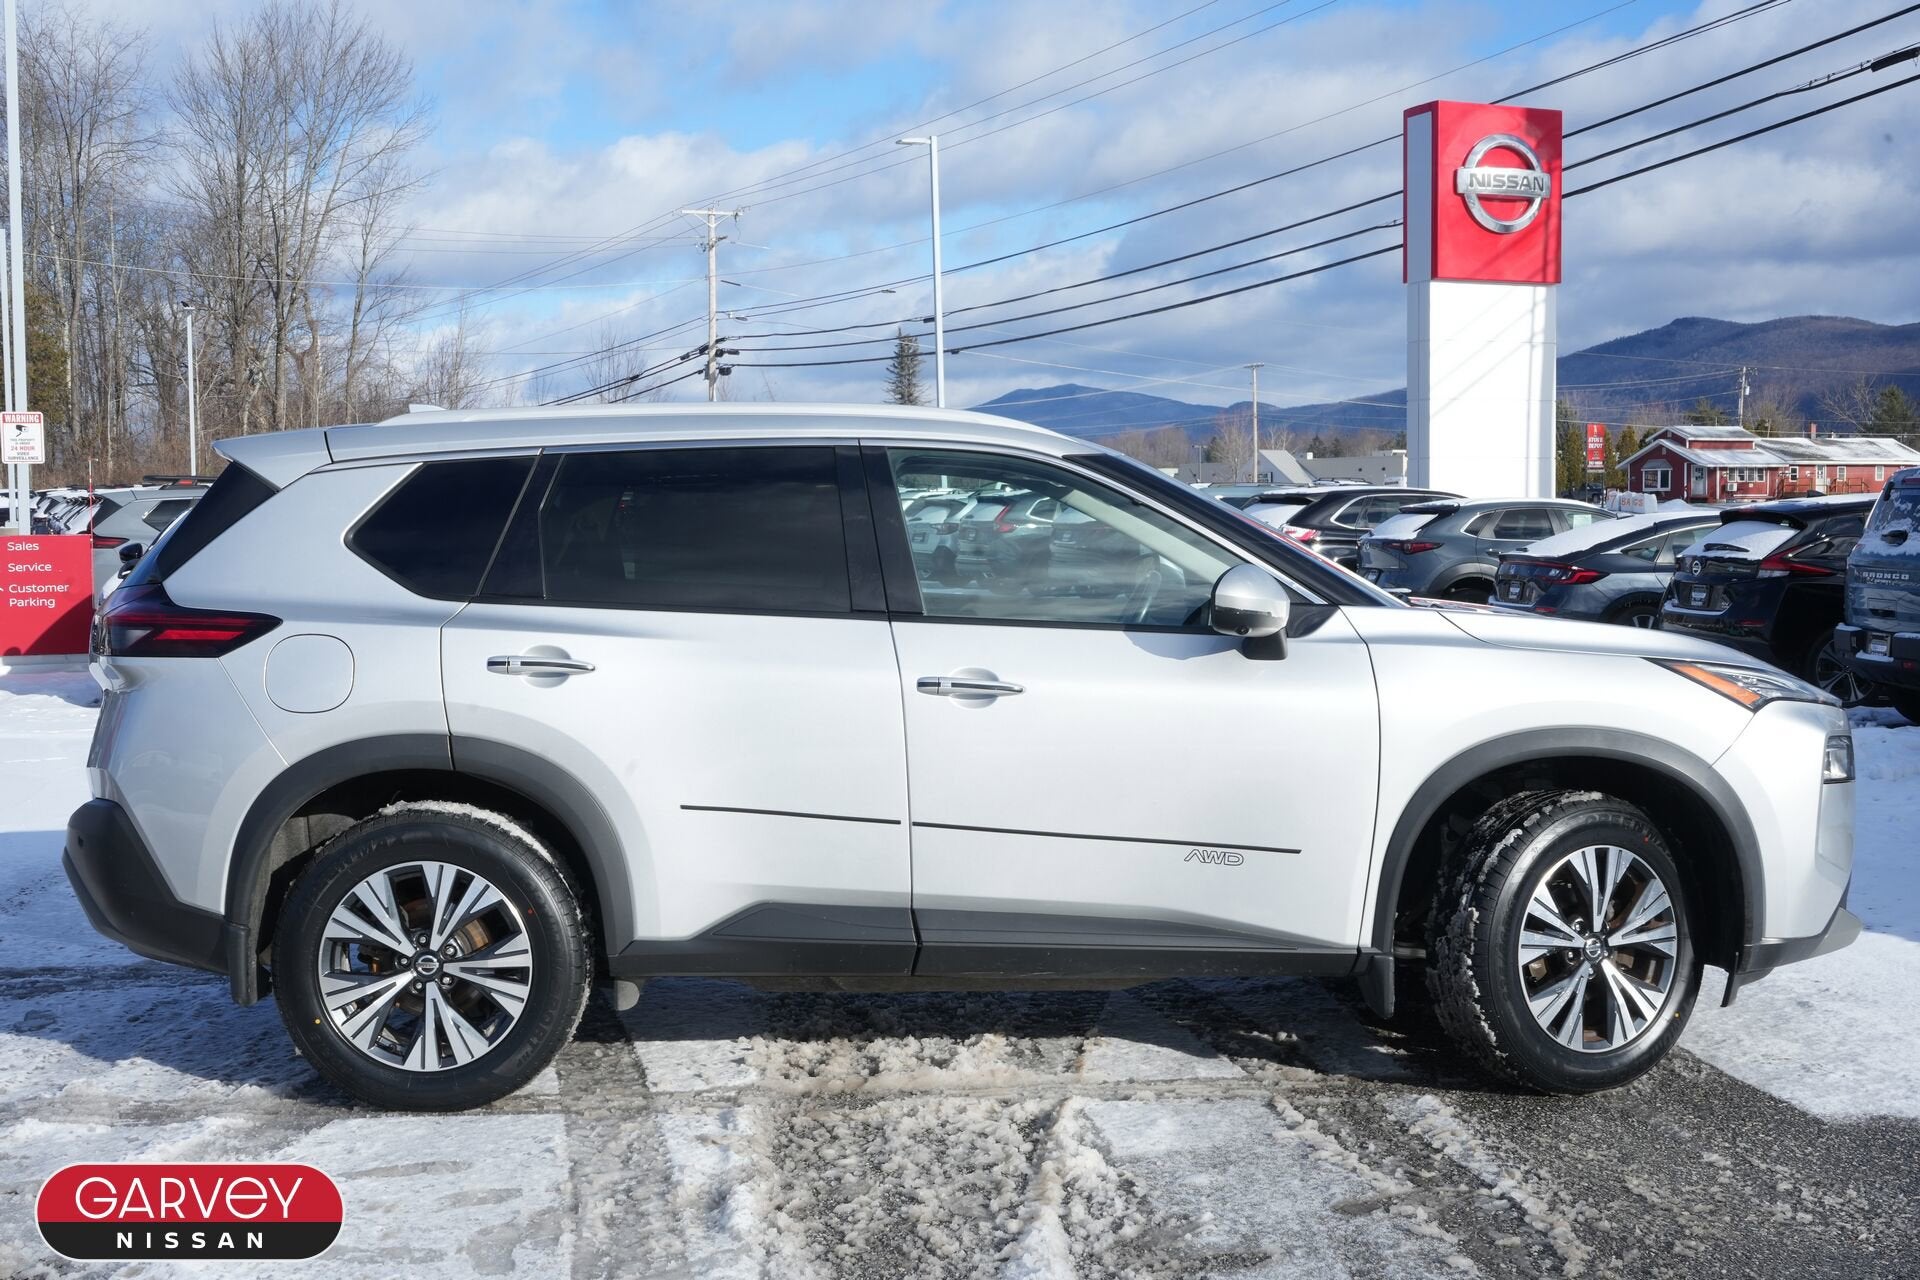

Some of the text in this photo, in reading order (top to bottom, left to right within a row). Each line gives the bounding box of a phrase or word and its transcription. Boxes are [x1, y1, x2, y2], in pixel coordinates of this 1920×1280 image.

[1468, 172, 1544, 192] NISSAN
[5, 414, 39, 423] WARNING
[7, 541, 39, 551] Sales
[8, 563, 52, 573] Service
[1862, 571, 1910, 580] BRONCO
[8, 584, 70, 594] Customer
[9, 597, 56, 609] Parking
[1184, 849, 1244, 867] AWD
